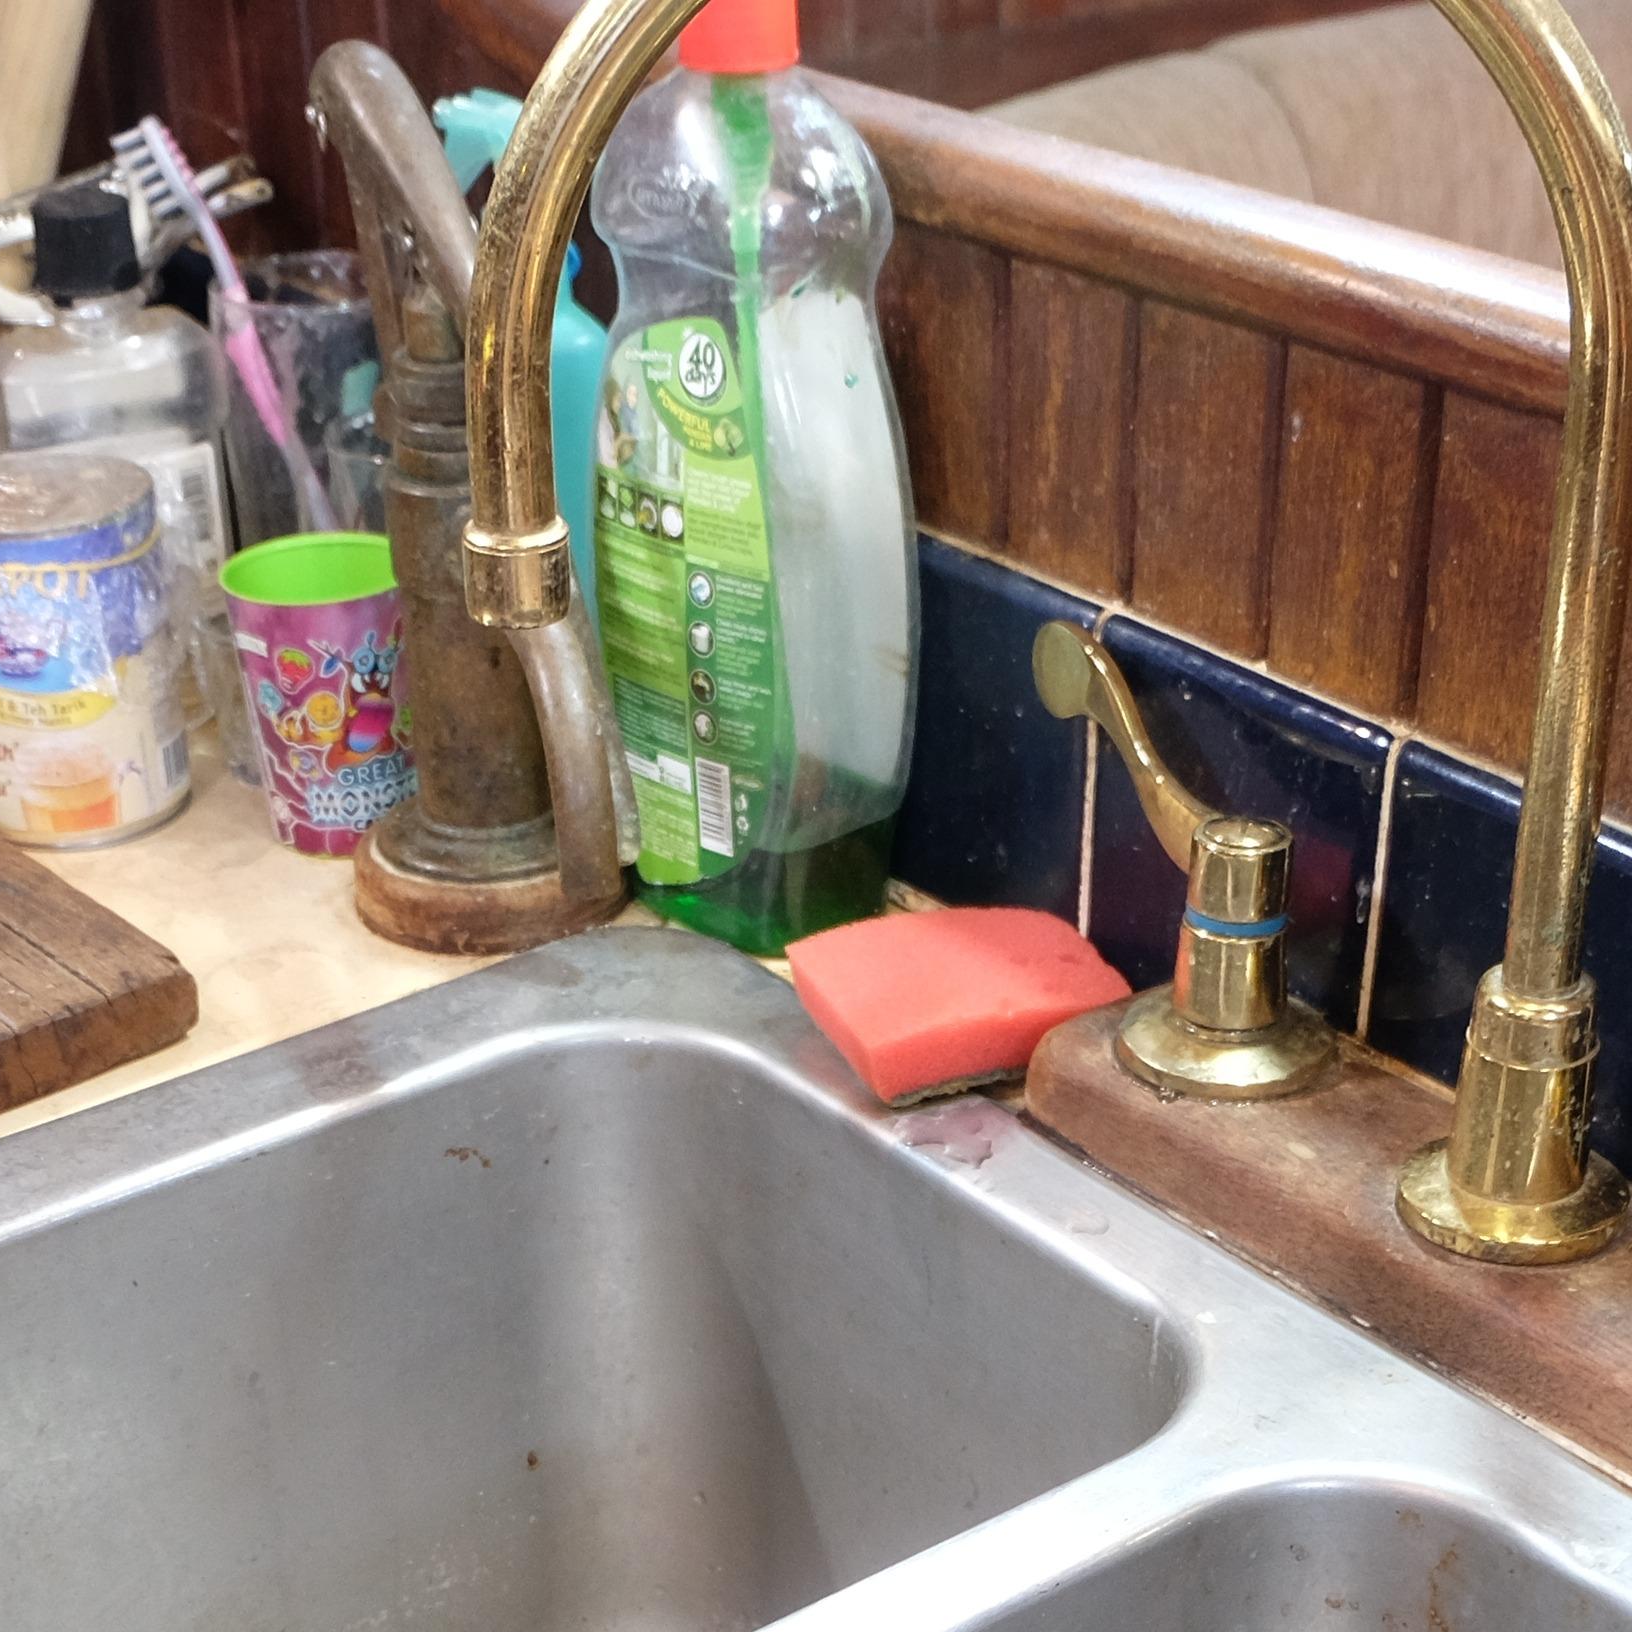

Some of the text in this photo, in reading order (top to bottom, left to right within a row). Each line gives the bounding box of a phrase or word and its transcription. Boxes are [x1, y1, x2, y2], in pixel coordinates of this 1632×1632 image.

[687, 336, 716, 371] 40
[685, 367, 716, 396] days
[22, 702, 47, 717] Teh
[338, 755, 404, 785] GREAT
[311, 770, 418, 820] MONSTE
